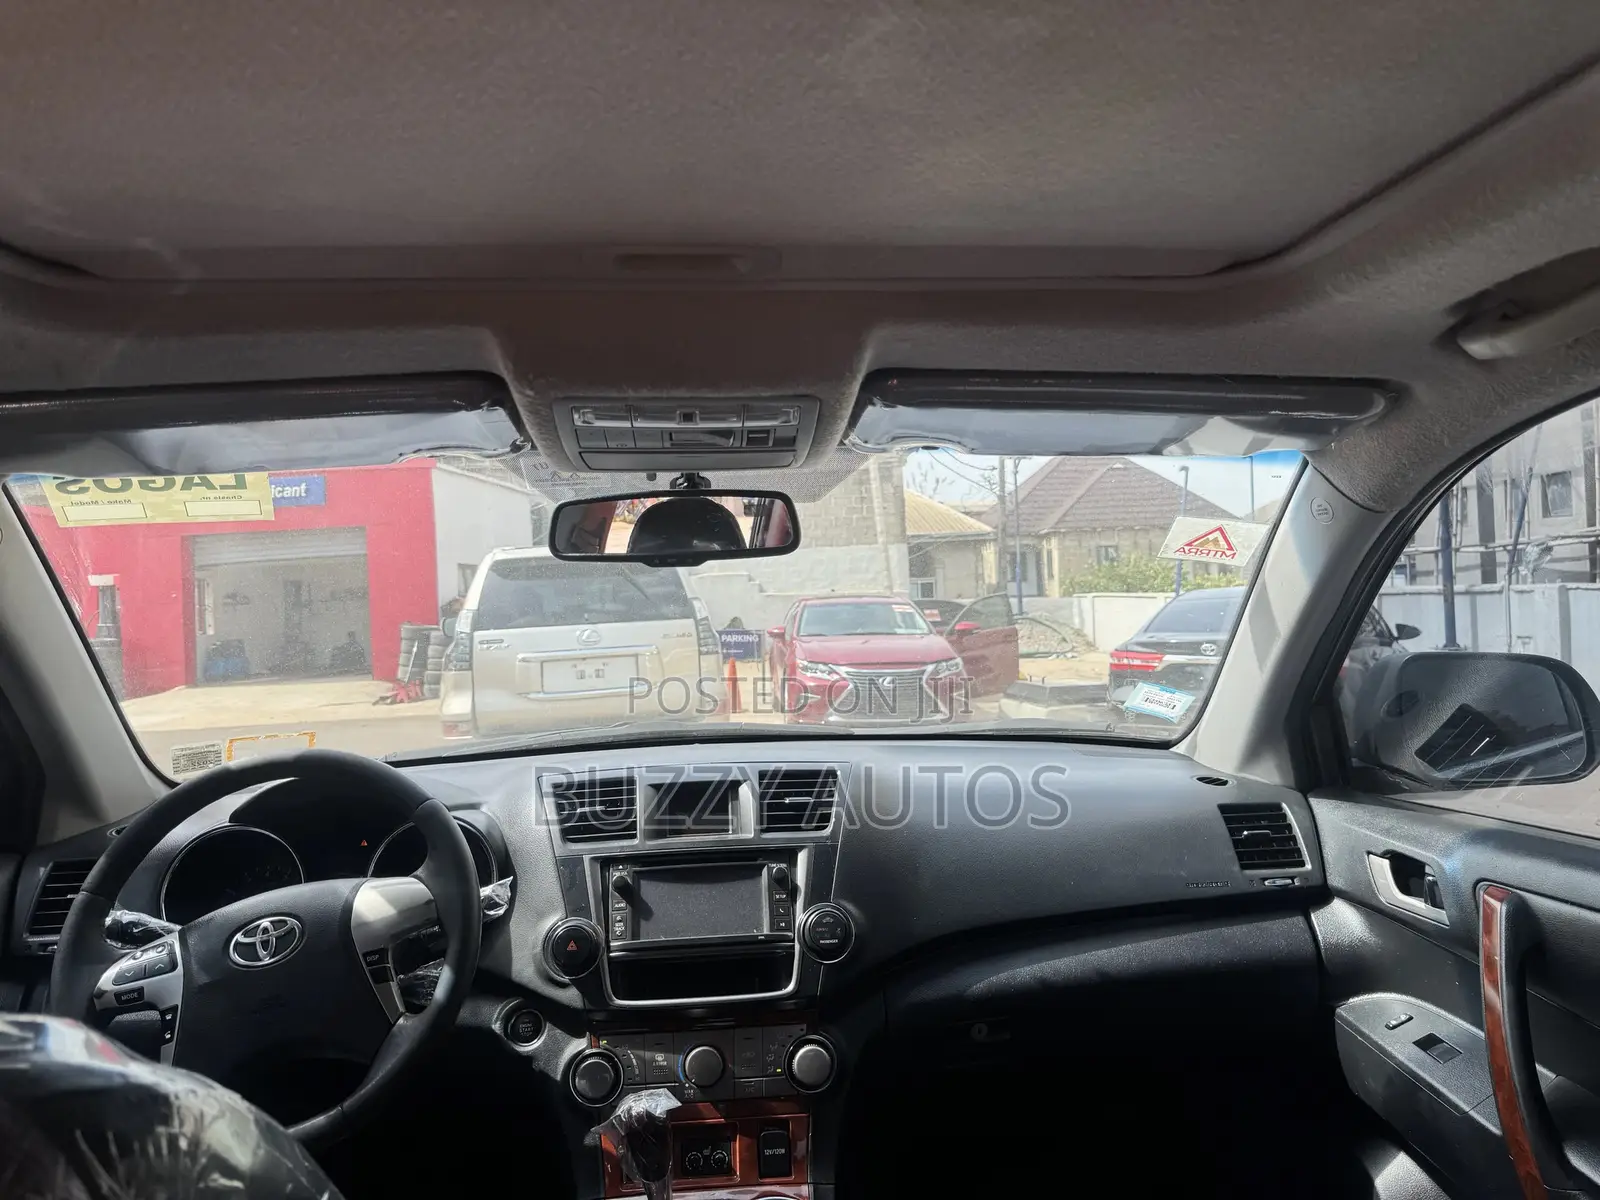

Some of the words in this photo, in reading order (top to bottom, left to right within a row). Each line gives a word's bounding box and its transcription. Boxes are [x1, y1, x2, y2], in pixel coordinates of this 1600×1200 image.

[271, 482, 307, 498] icant
[721, 633, 759, 642] PARKING
[366, 954, 380, 962] DISP
[121, 992, 139, 1001] MODE
